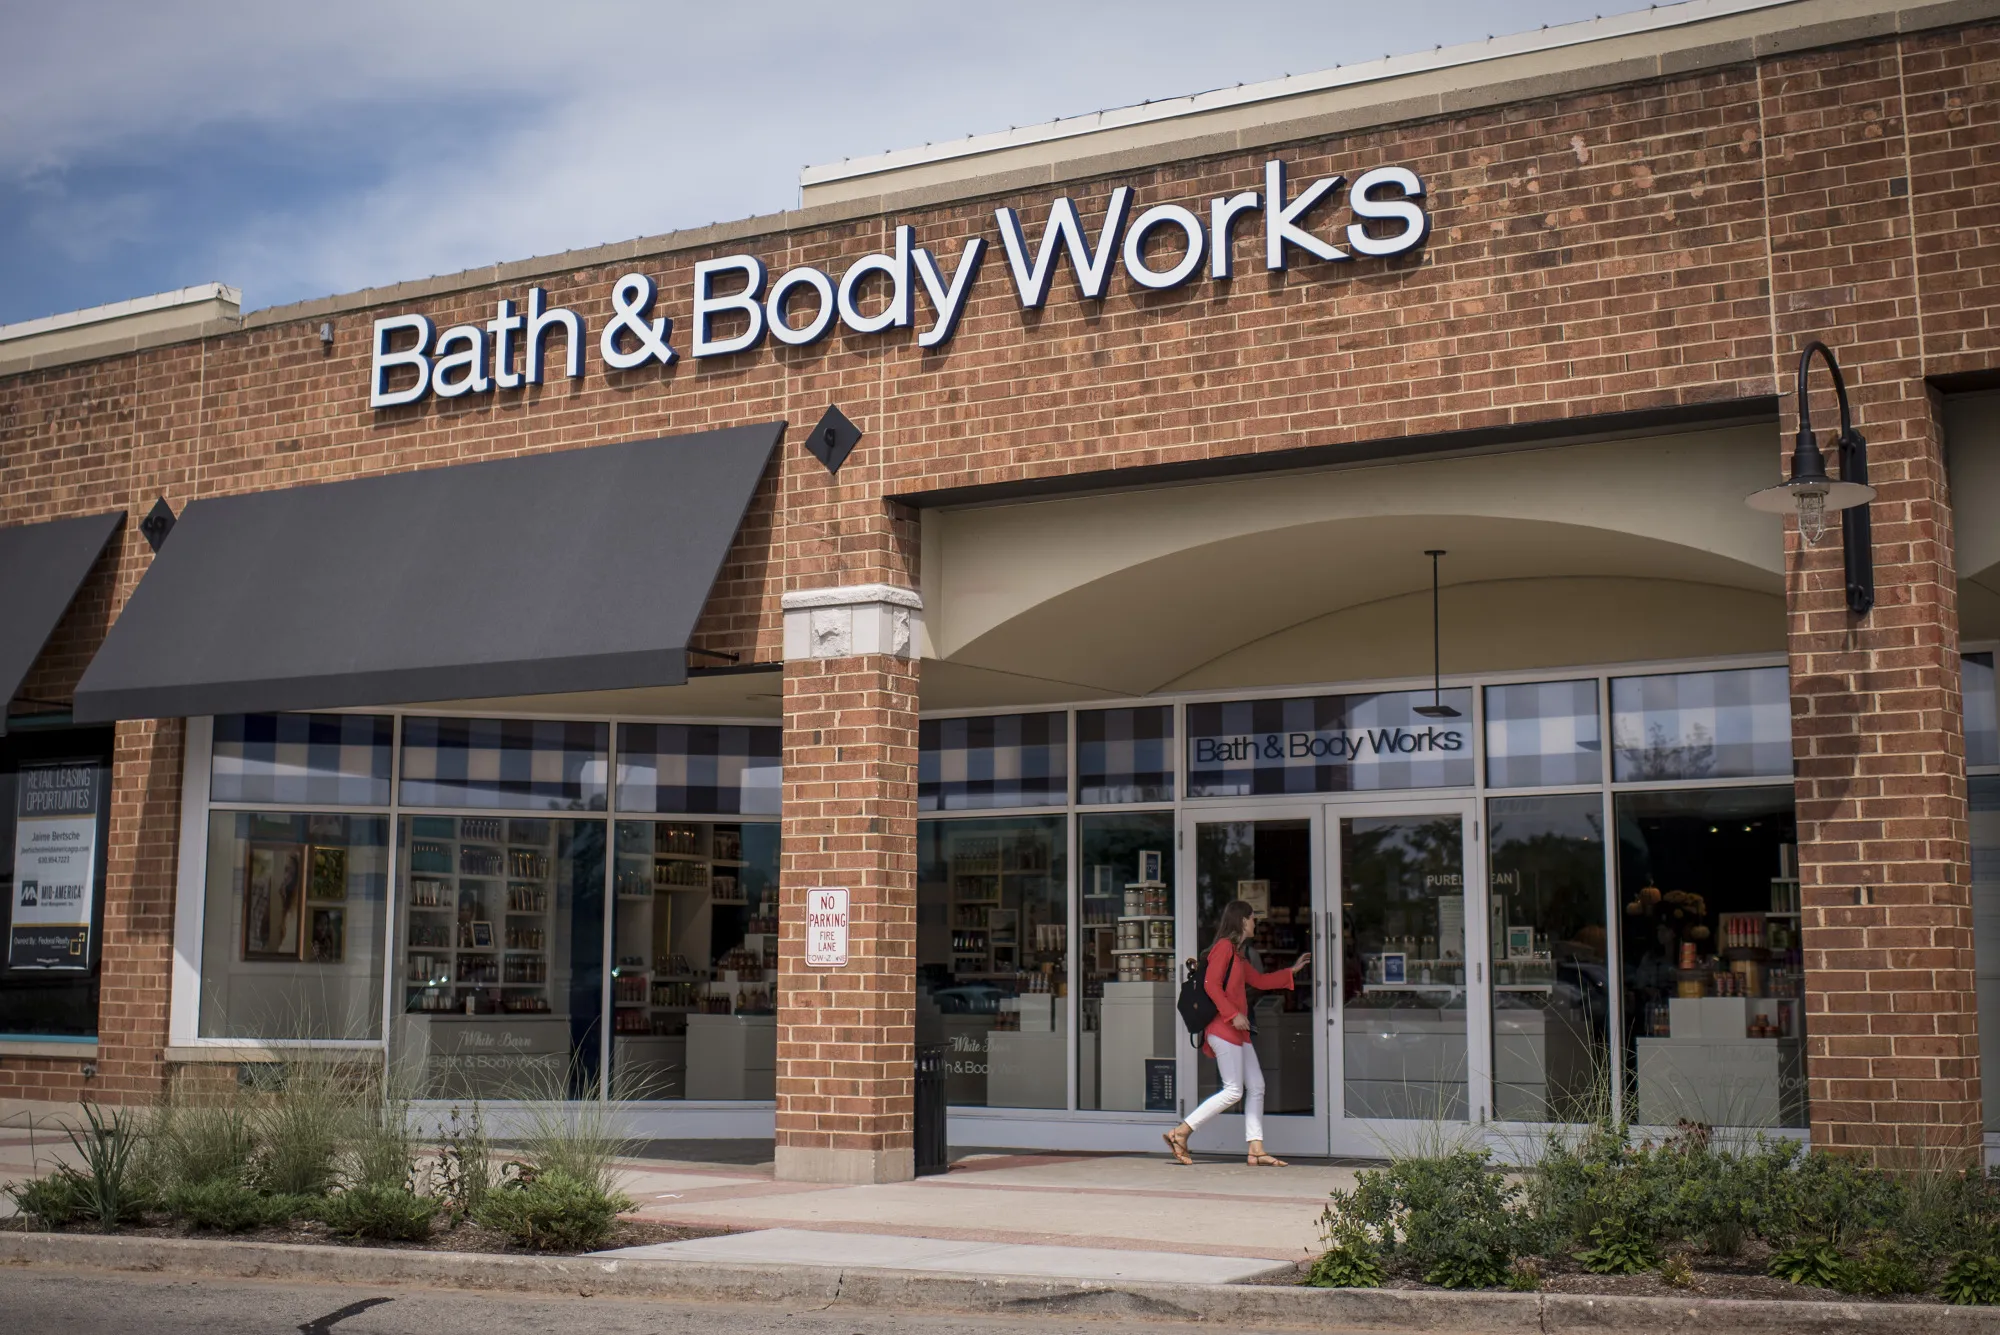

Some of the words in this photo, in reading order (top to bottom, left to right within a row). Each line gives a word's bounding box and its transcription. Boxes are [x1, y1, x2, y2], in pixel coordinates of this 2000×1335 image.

[370, 287, 586, 407] Bath
[600, 272, 680, 369] &
[692, 224, 989, 357] Body
[995, 159, 1430, 308] Works
[1196, 736, 1259, 763] Bath
[1263, 734, 1286, 760] &
[1289, 731, 1363, 761] Body
[1367, 726, 1463, 754] Works
[27, 770, 53, 789] RETAIL
[56, 768, 91, 788] LEASING
[27, 789, 90, 811] OPPORTUNITIES
[31, 831, 50, 842] Jaime
[1426, 874, 1464, 886] PUREL
[821, 896, 835, 910] NO
[810, 913, 846, 928] PARKING
[820, 931, 835, 941] FIRE
[818, 942, 837, 952] LANE
[457, 1030, 496, 1047] White
[497, 1031, 532, 1047] Barn
[950, 1036, 981, 1052] White
[465, 1055, 475, 1068] &
[477, 1055, 514, 1072] Body
[953, 1060, 963, 1074] &
